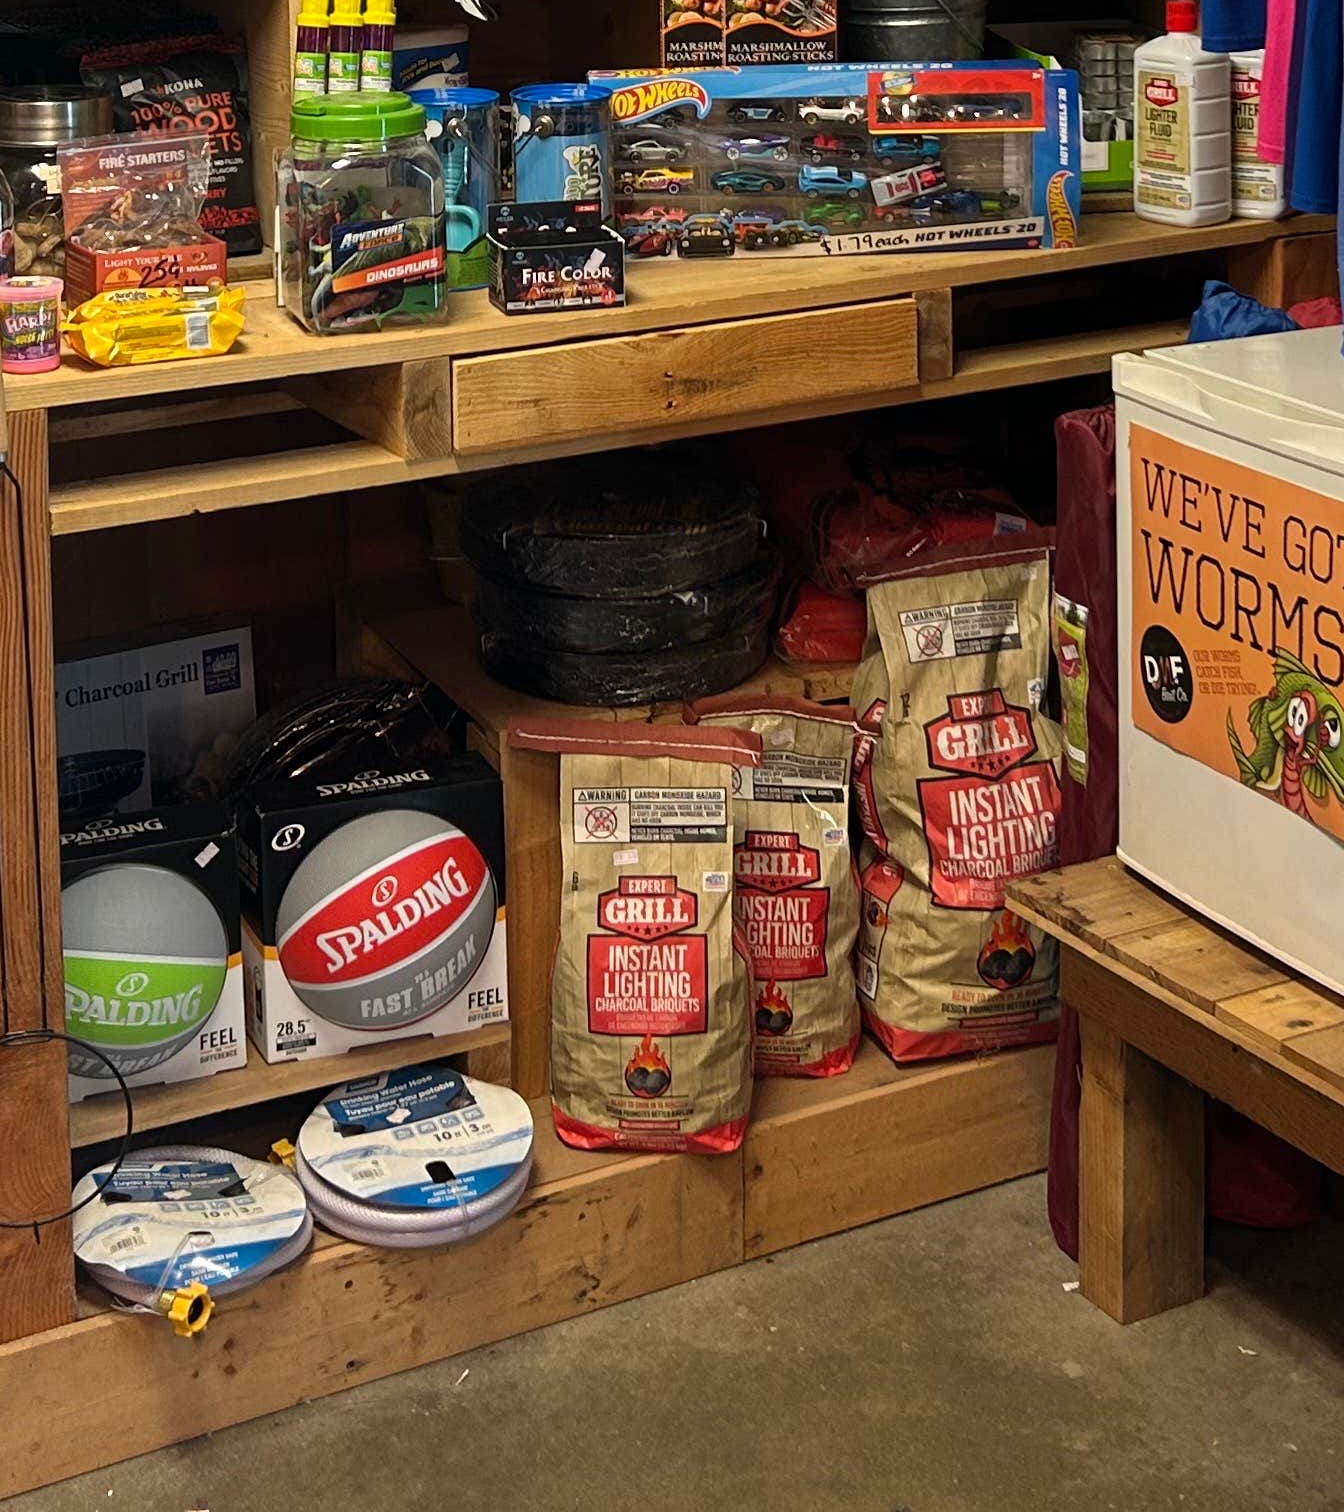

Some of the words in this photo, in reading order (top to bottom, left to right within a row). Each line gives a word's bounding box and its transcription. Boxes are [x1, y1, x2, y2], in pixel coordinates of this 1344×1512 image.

[728, 51, 791, 63] ROASTING
[792, 50, 834, 61] STICKS
[731, 41, 827, 52] MARSHMALLOW
[164, 77, 203, 95] KONA
[1058, 88, 1067, 105] 20
[131, 101, 183, 124] 100%
[185, 92, 232, 112] PURE
[1145, 108, 1178, 125] LIGHTER
[1059, 107, 1068, 147] WHEELS
[1150, 124, 1172, 138] FLUID
[99, 154, 124, 169] FIRE
[127, 149, 186, 168] STARTERS
[1059, 148, 1068, 166] HOT
[915, 230, 945, 241] HOT
[948, 225, 1012, 240] WHEELS
[1016, 223, 1036, 233] 20
[820, 236, 872, 255] $1.79
[874, 237, 908, 249] each
[367, 258, 439, 283] DINOSAURS
[523, 268, 555, 285] FIRE
[561, 265, 612, 281] COLOR
[1141, 458, 1266, 559] WE'VE
[913, 608, 948, 624] WARNING
[65, 677, 152, 709] Charcoal
[155, 662, 198, 690] Grill
[936, 717, 1028, 760] GRILL
[317, 770, 431, 797] SPALDING
[587, 790, 627, 800] WARNING
[949, 776, 1045, 825] INSTANT
[61, 819, 164, 846] PALDING
[756, 835, 790, 848] EXPERT
[947, 811, 1056, 860] LIGHTING
[735, 852, 811, 877] GRILL
[629, 880, 666, 894] EXPERT
[317, 857, 471, 974] SPALDING
[605, 898, 689, 924] GRILL
[609, 945, 688, 971] INSTANT
[604, 973, 691, 999] LIGHTING
[65, 983, 202, 1028] PALDING
[361, 988, 413, 1019] FAST
[467, 988, 504, 1010] FEEL
[595, 998, 649, 1013] CHARCOAL
[651, 998, 700, 1013] BRIQUETS
[467, 1010, 504, 1023] DIFFERENCE
[276, 1019, 306, 1037] 28.5
[199, 1030, 237, 1050] FEEL
[200, 1049, 237, 1064] DIFFERENCE
[340, 1090, 376, 1106] Drinking
[378, 1083, 405, 1100] Water
[407, 1075, 433, 1090] Hose
[345, 1104, 373, 1118] Tuyau
[375, 1098, 397, 1114] pour
[399, 1094, 417, 1106] eau
[419, 1080, 455, 1101] potable
